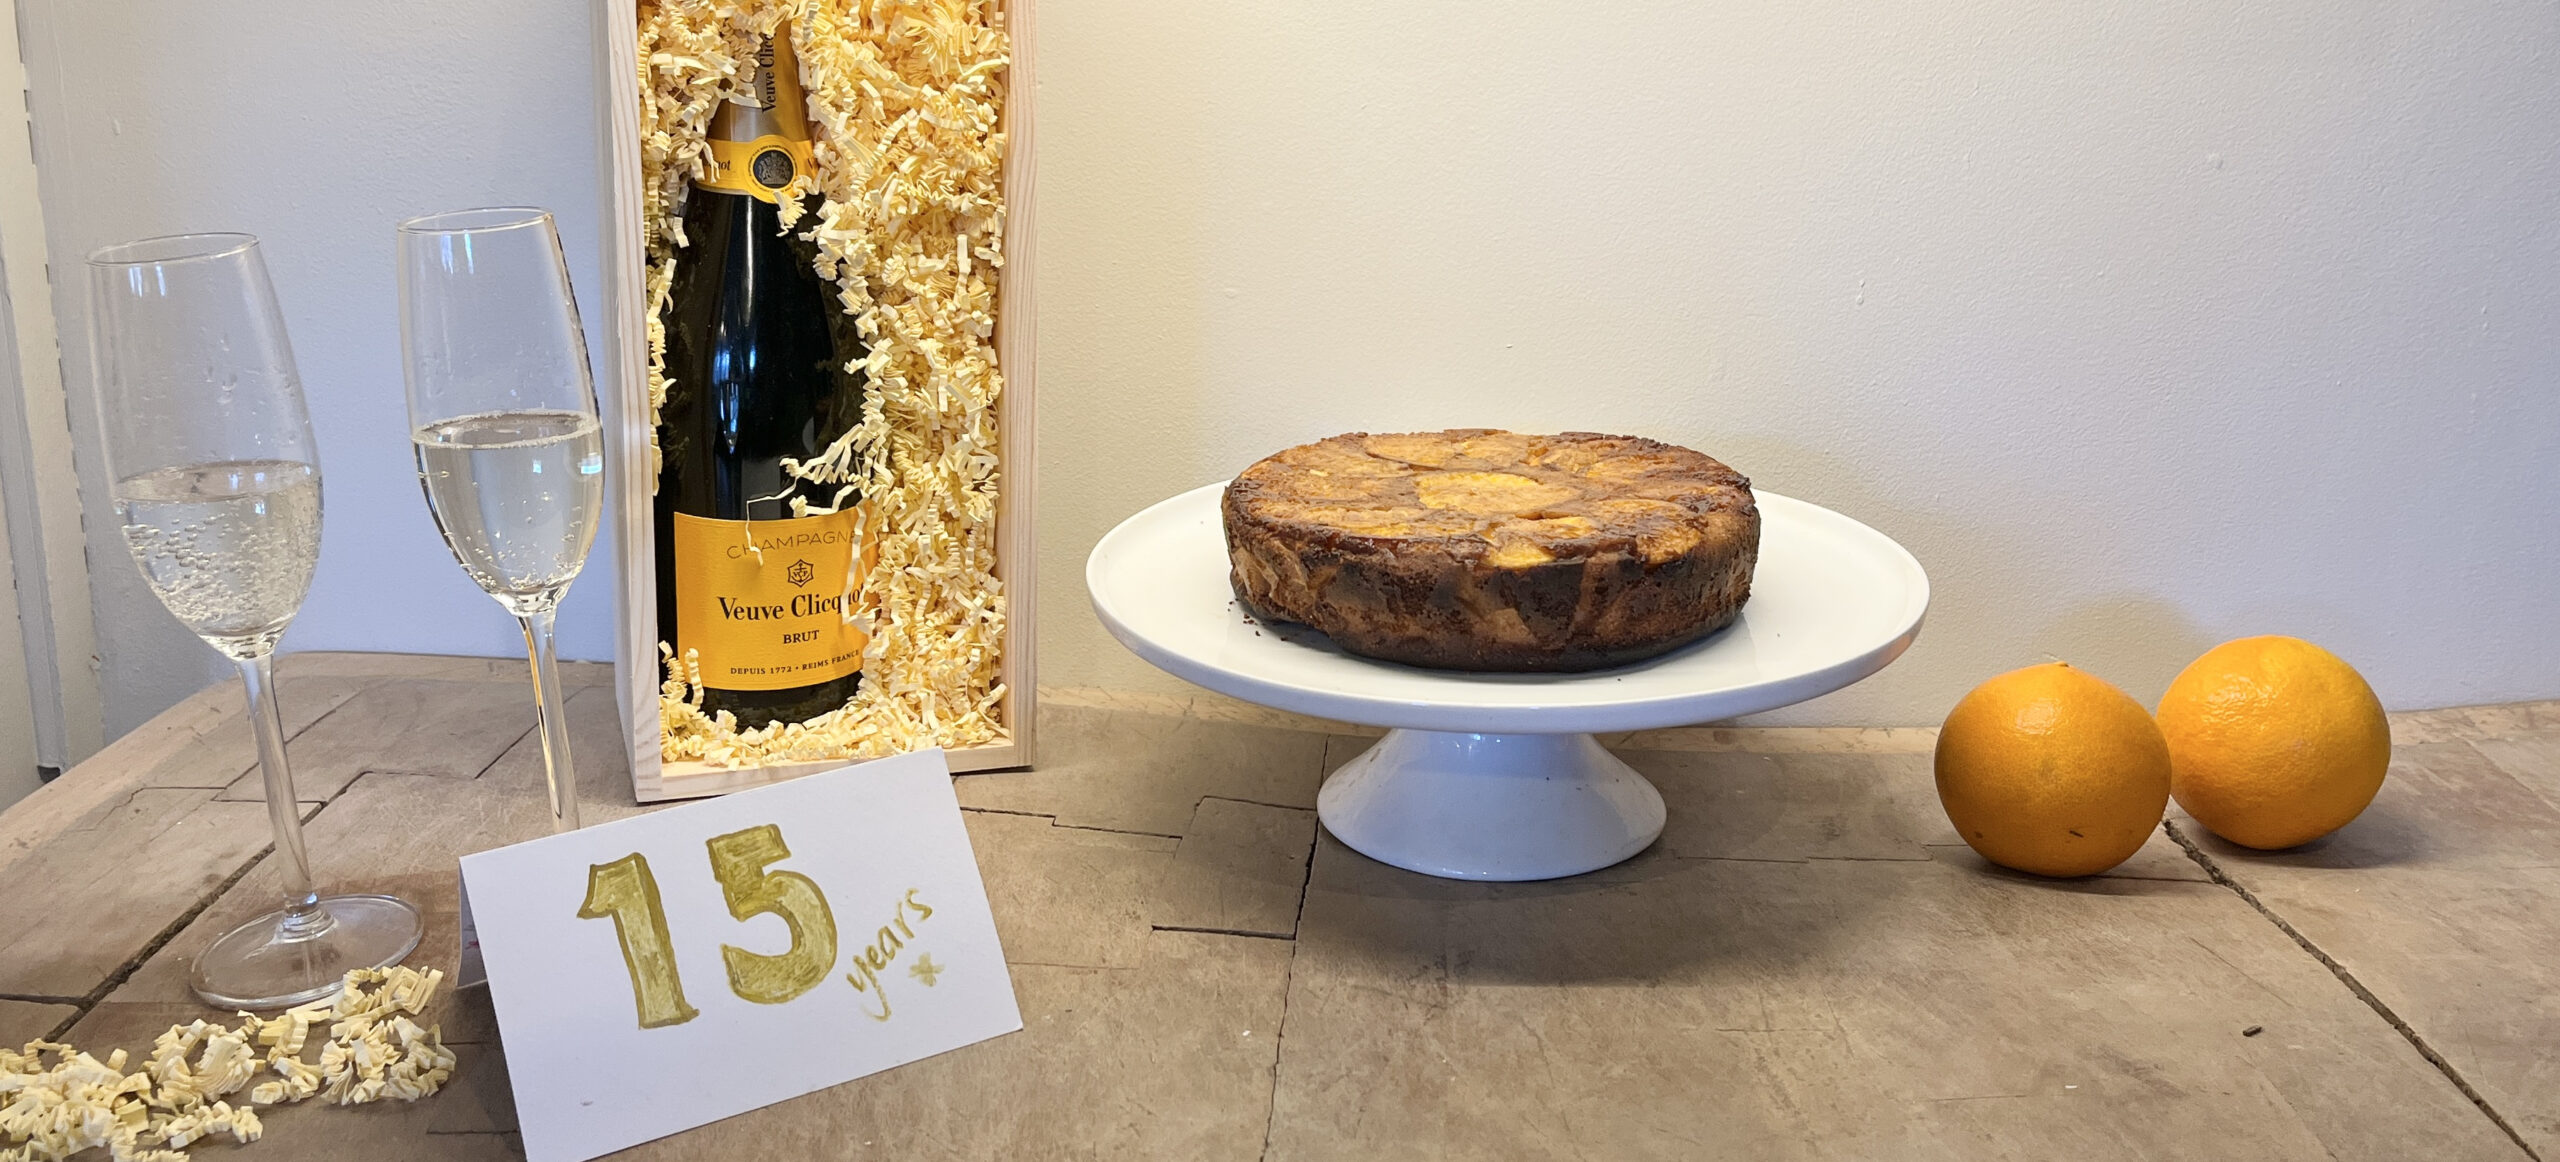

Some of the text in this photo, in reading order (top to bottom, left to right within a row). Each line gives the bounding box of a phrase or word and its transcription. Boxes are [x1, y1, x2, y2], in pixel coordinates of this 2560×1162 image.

[761, 71, 777, 113] Veuve
[717, 596, 784, 621] Veuve
[783, 630, 820, 644] BRUT
[730, 649, 860, 675] DEPUIS 1772 REIMS FRANCE
[576, 823, 934, 1031] 15 years
